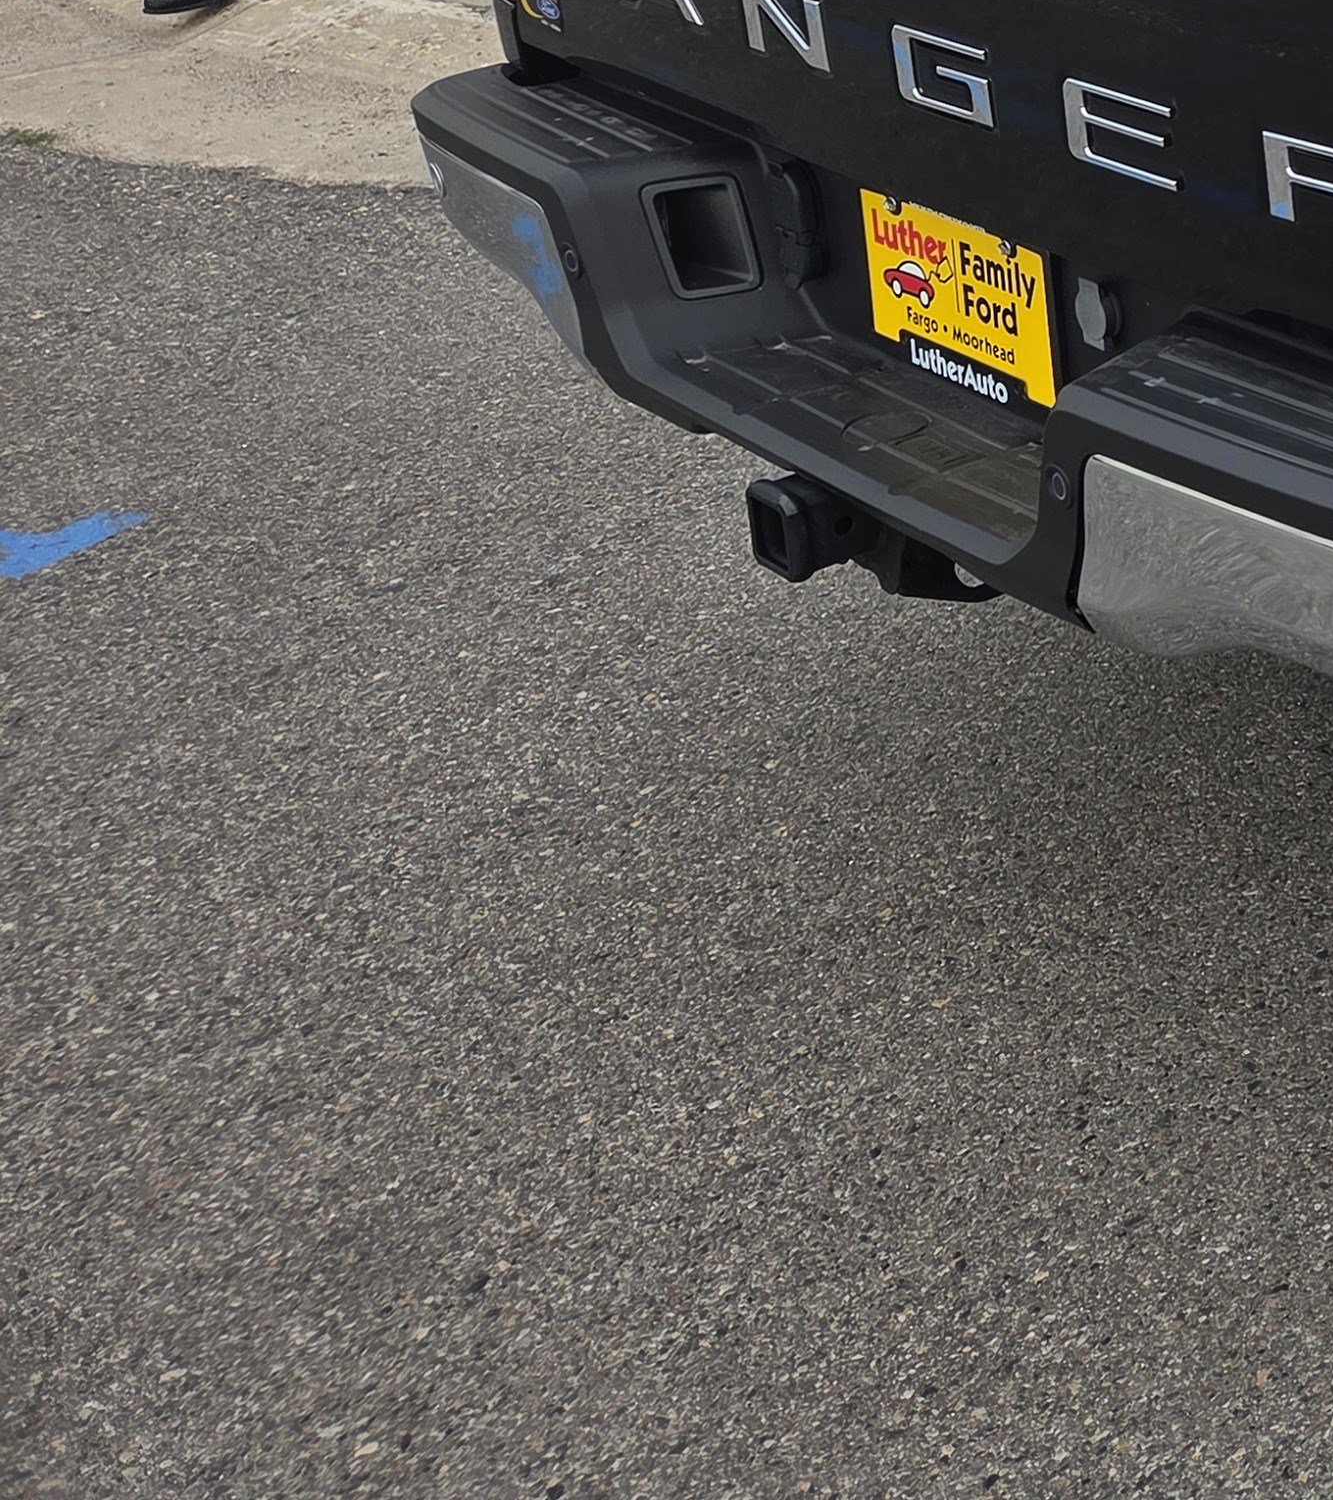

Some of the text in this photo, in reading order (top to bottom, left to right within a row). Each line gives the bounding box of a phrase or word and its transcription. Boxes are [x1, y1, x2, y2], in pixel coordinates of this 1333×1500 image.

[871, 208, 946, 265] Luther
[959, 241, 1036, 309] Family
[907, 306, 1016, 365] Fargo Moorhead
[962, 285, 1019, 336] Ford
[909, 338, 1009, 404] LutherAuto
